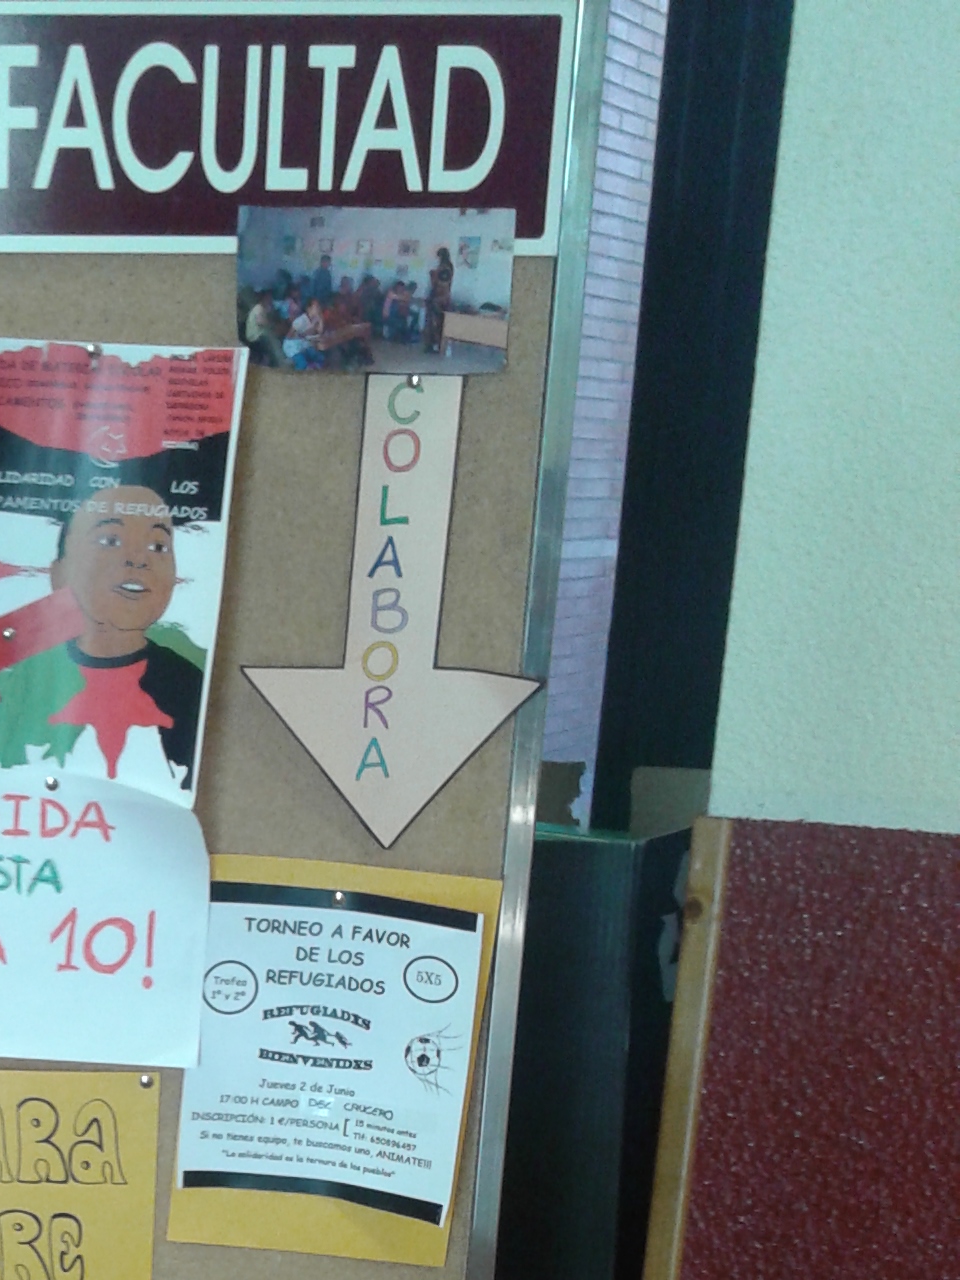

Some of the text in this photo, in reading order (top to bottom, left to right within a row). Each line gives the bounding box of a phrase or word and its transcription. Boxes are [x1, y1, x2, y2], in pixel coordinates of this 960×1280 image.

[90, 475, 122, 489] CON
[170, 481, 199, 495] LOS
[88, 501, 108, 514] DE
[114, 502, 209, 520] REFUGIADOS
[355, 381, 425, 781] COLABORA
[244, 917, 411, 949] TORNEO A FAVOR
[50, 907, 156, 989] 10!
[295, 946, 365, 966] DE LOS
[265, 968, 386, 996] REFUGIADOS
[262, 1004, 371, 1031] REFUGIADXS
[258, 1047, 374, 1071] BIENVENIDXS
[258, 1078, 356, 1098] Jueves 2 de Junio
[219, 1094, 249, 1105] 17:00
[261, 1097, 300, 1109] CAMPO
[343, 1102, 394, 1121] CRUCERO
[200, 1130, 209, 1140] Si
[211, 1132, 224, 1140] no
[226, 1132, 255, 1143] tienes
[293, 1137, 303, 1146] te
[305, 1138, 353, 1153] buscamos
[238, 1150, 283, 1161] solidaridad
[338, 1160, 348, 1169] de
